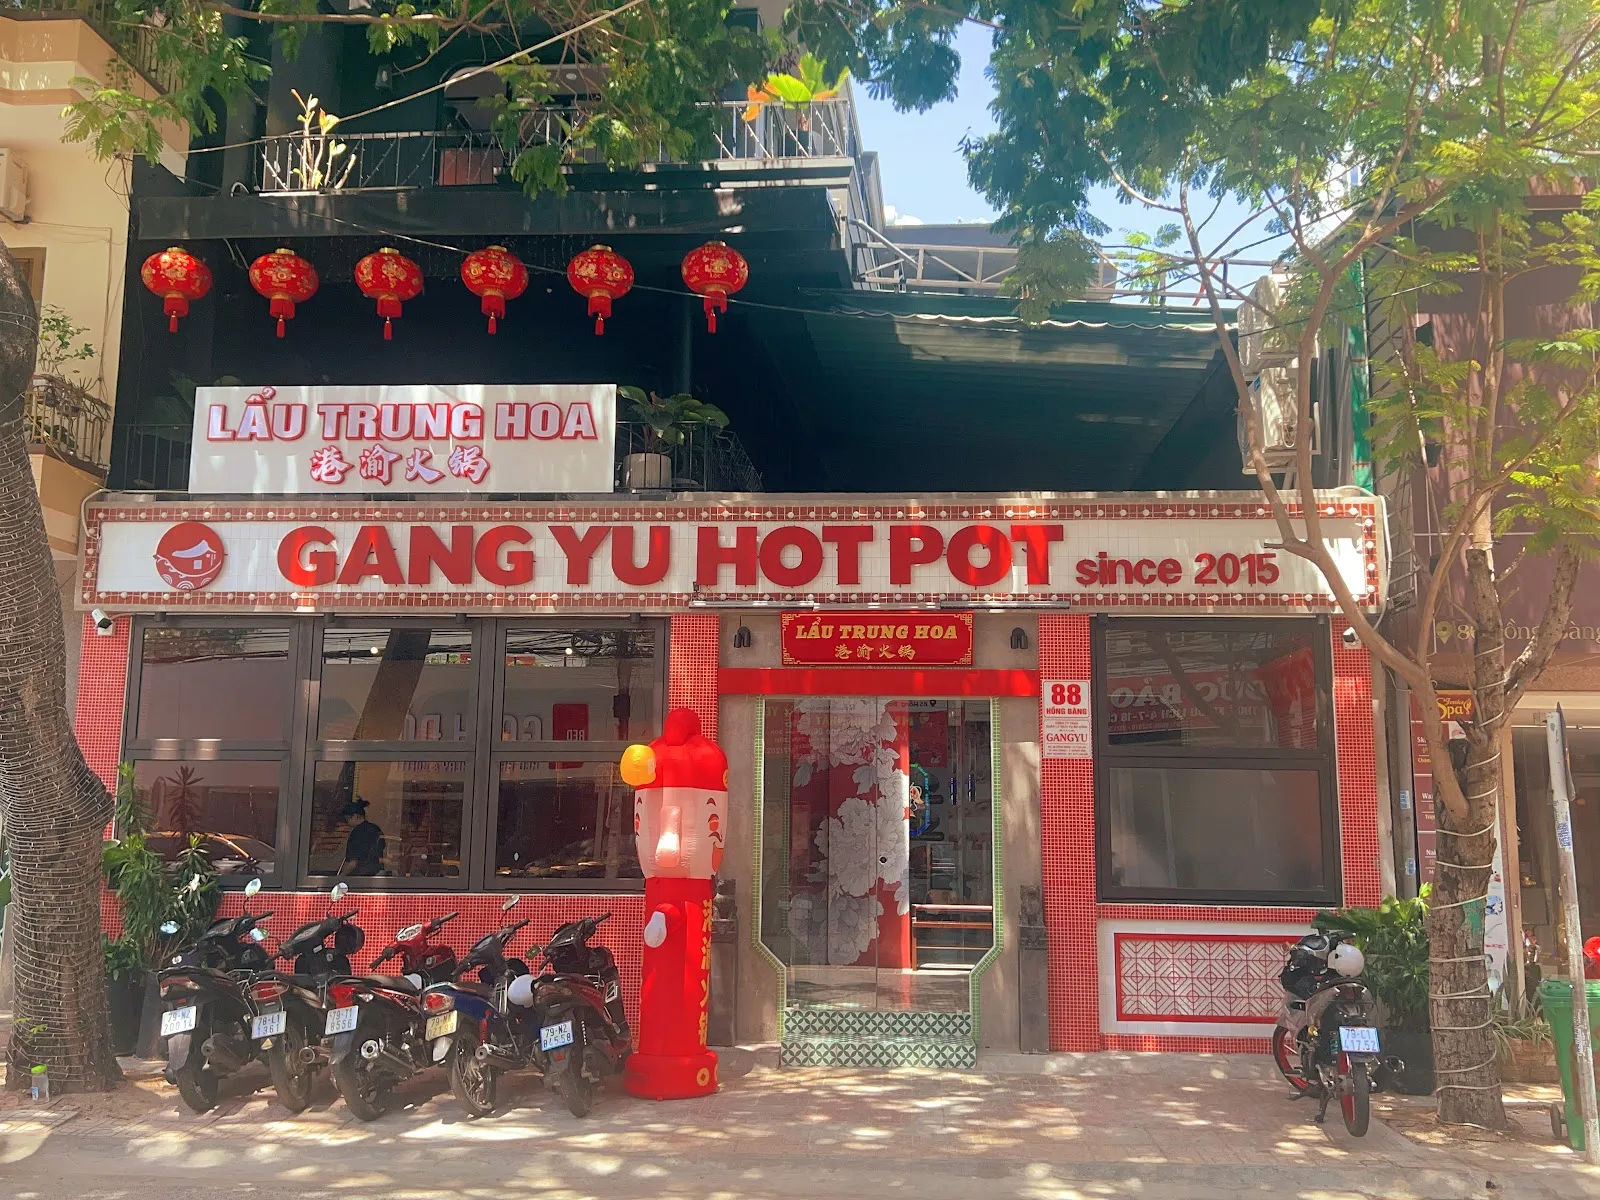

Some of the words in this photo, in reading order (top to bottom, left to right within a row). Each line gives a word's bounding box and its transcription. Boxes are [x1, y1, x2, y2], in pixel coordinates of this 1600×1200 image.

[207, 386, 307, 441] LẨU
[318, 402, 484, 441] TRUNG
[494, 402, 598, 441] HOA
[309, 444, 490, 485] 港渝火锅
[276, 525, 534, 587] GANG
[547, 525, 671, 586] YU
[696, 525, 874, 587] HOT
[889, 525, 1064, 587] POT
[1075, 551, 1183, 586] since
[1194, 552, 1280, 585] 2015
[795, 616, 834, 640] LẨU
[839, 624, 909, 640] TRUNG
[913, 624, 958, 640] HOA
[834, 643, 916, 661] 港渝火锅
[1051, 683, 1082, 705] 88
[1436, 698, 1464, 719] Spa
[1046, 732, 1088, 743] GANGYU
